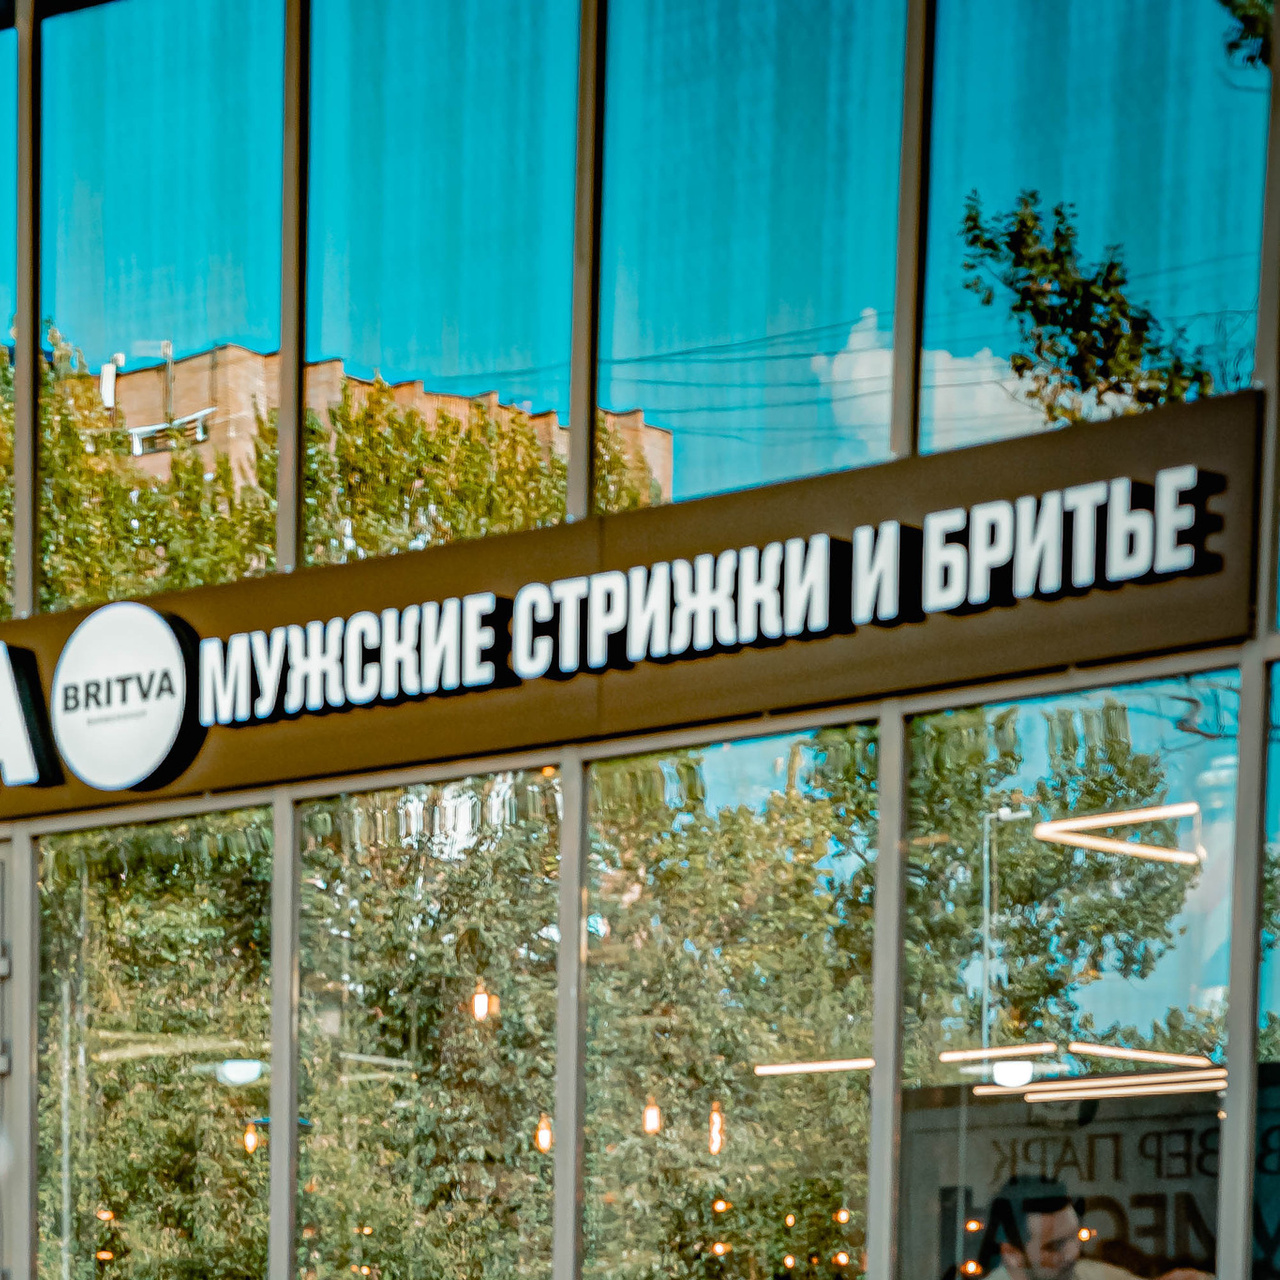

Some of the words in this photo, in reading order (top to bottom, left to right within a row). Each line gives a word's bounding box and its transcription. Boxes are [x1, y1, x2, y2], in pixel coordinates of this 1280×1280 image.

[198, 591, 496, 728] МУЖСКИЕ
[513, 532, 831, 681] СТРИЖКИ
[851, 519, 901, 626] И
[921, 463, 1199, 614] БРИТЬЕ
[62, 668, 177, 713] BRITVA
